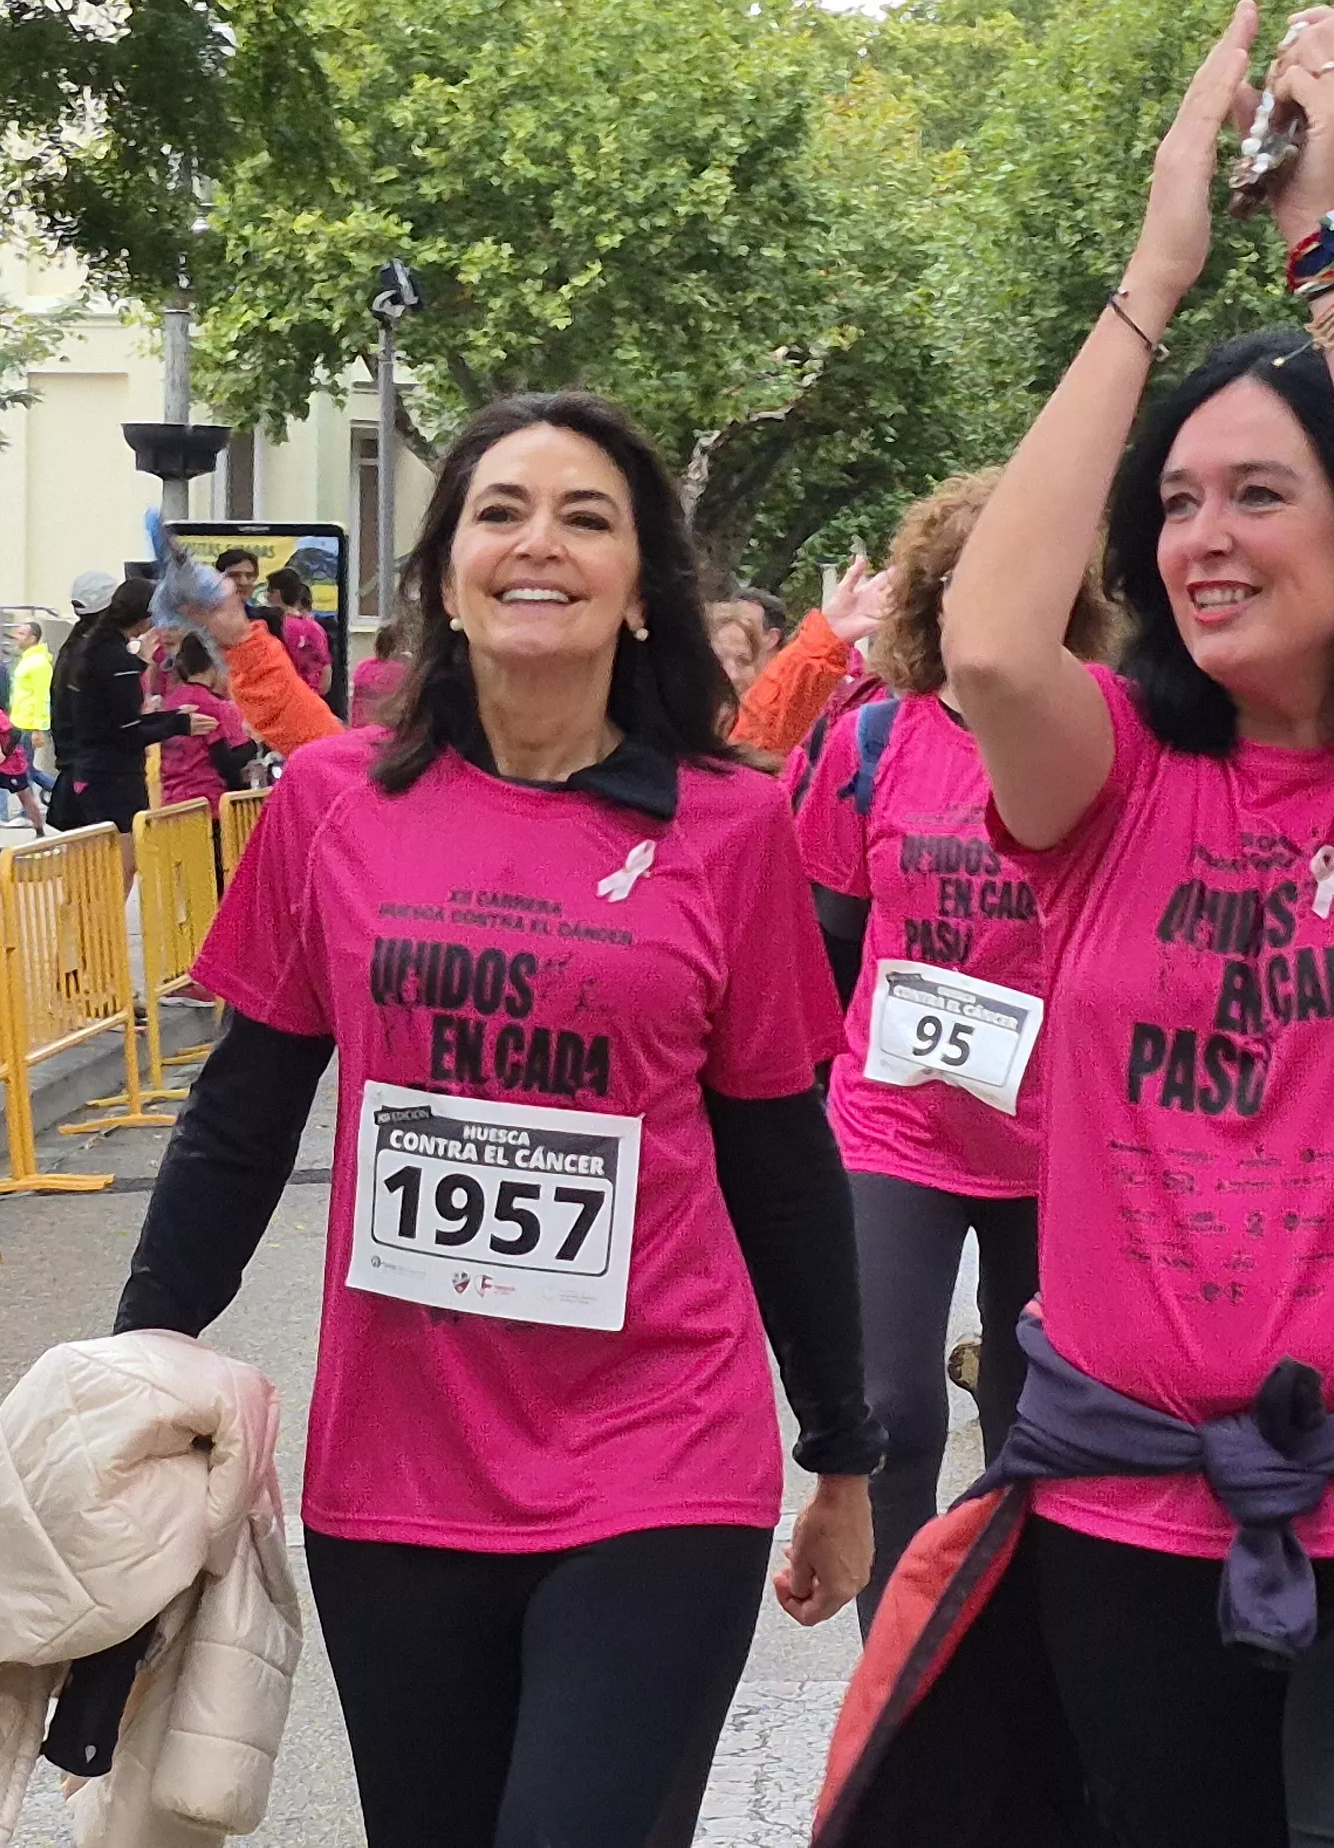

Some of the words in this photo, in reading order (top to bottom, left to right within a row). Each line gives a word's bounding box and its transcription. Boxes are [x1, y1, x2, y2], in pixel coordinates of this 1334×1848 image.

[451, 909, 525, 932] CONTRA
[477, 890, 563, 915] CARRERA
[980, 880, 1038, 921] CAD
[370, 936, 539, 1019] UNIDOS
[430, 1013, 487, 1084] EN
[494, 1022, 612, 1097] CADA
[911, 1015, 976, 1067] 95
[389, 1129, 478, 1163] CONTRA
[484, 1145, 509, 1166] EL
[514, 1145, 605, 1176] CÁNCER
[462, 1124, 531, 1147] HUESCA
[383, 1165, 606, 1262] 1957
